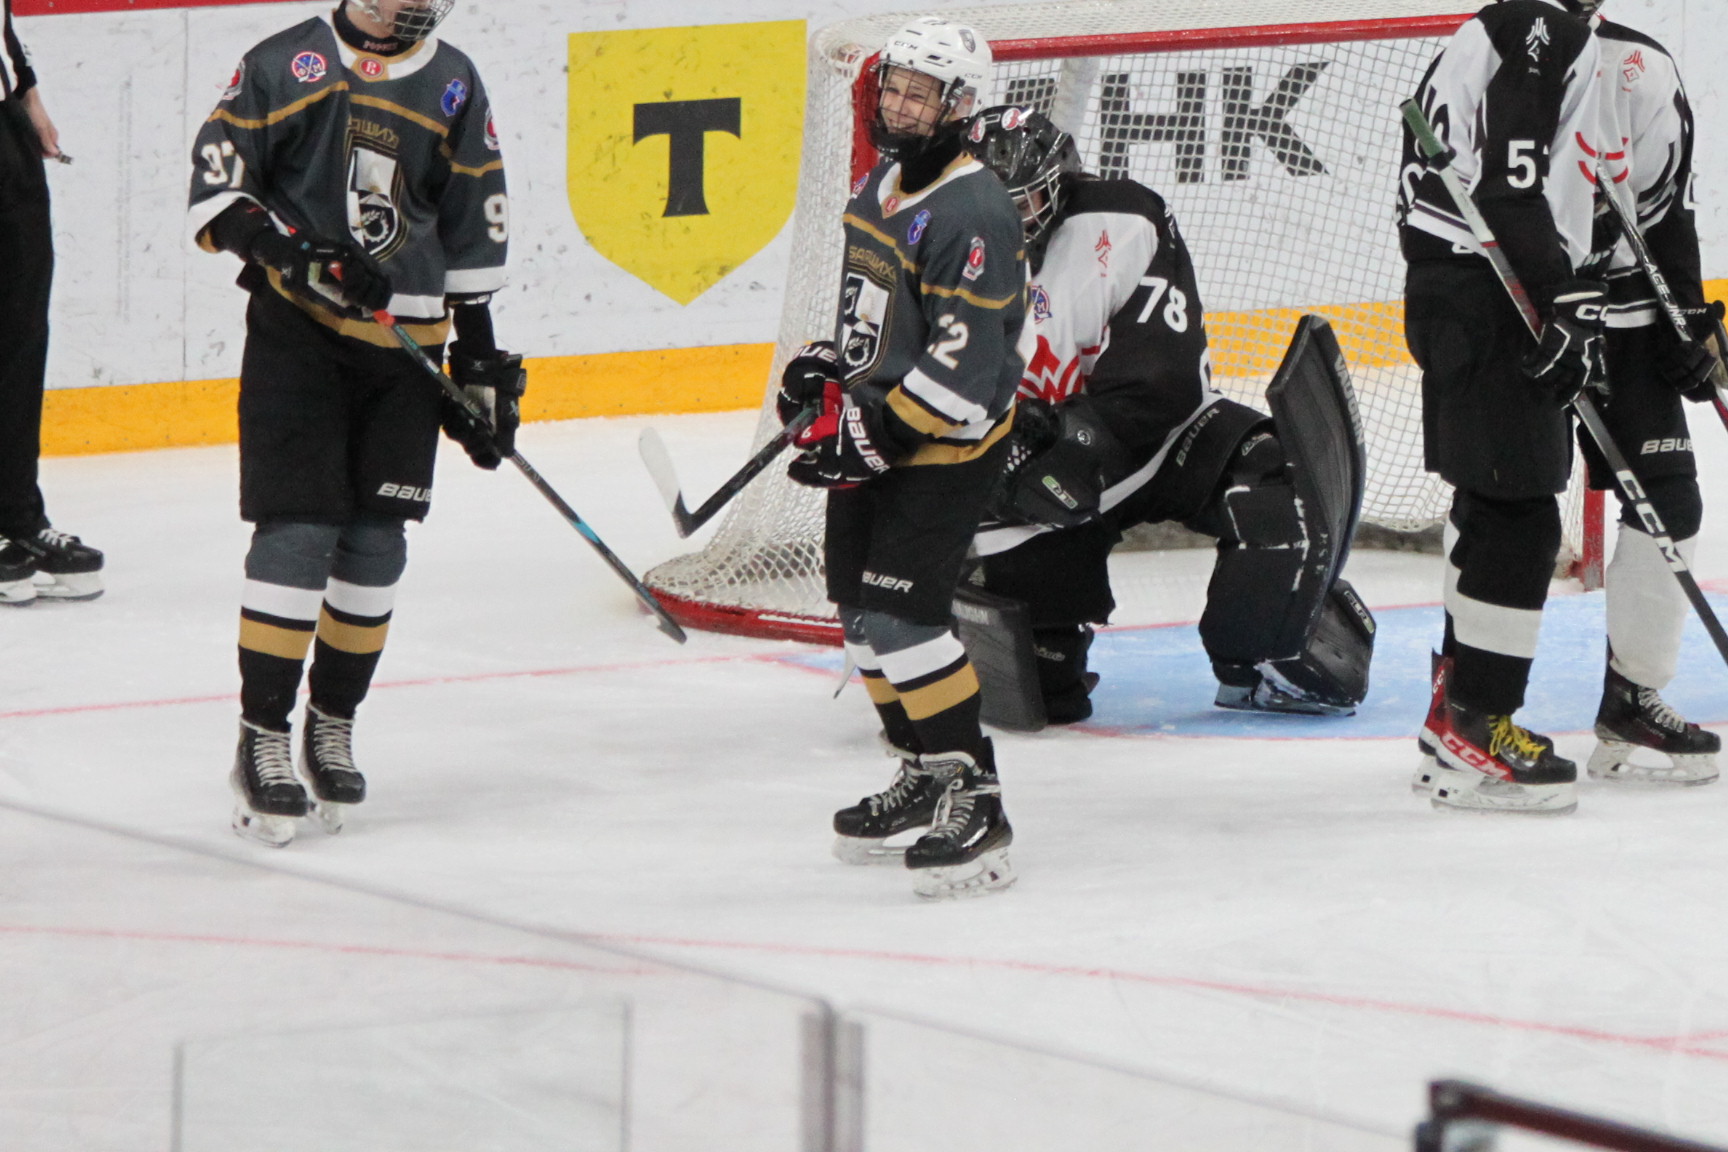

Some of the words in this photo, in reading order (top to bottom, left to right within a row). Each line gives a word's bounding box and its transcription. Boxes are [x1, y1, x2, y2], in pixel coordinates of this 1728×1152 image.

[201, 140, 245, 189] 97
[633, 97, 742, 218] Т
[1506, 140, 1550, 189] 5
[1137, 276, 1188, 333] 78
[1334, 354, 1366, 446] VAUGHN
[846, 405, 891, 475] BAUER
[1176, 406, 1220, 467] BAUER
[1641, 437, 1694, 456] BAUE
[377, 481, 432, 503] BAUE
[1616, 470, 1688, 573] CCM
[1441, 731, 1509, 779] CCM
